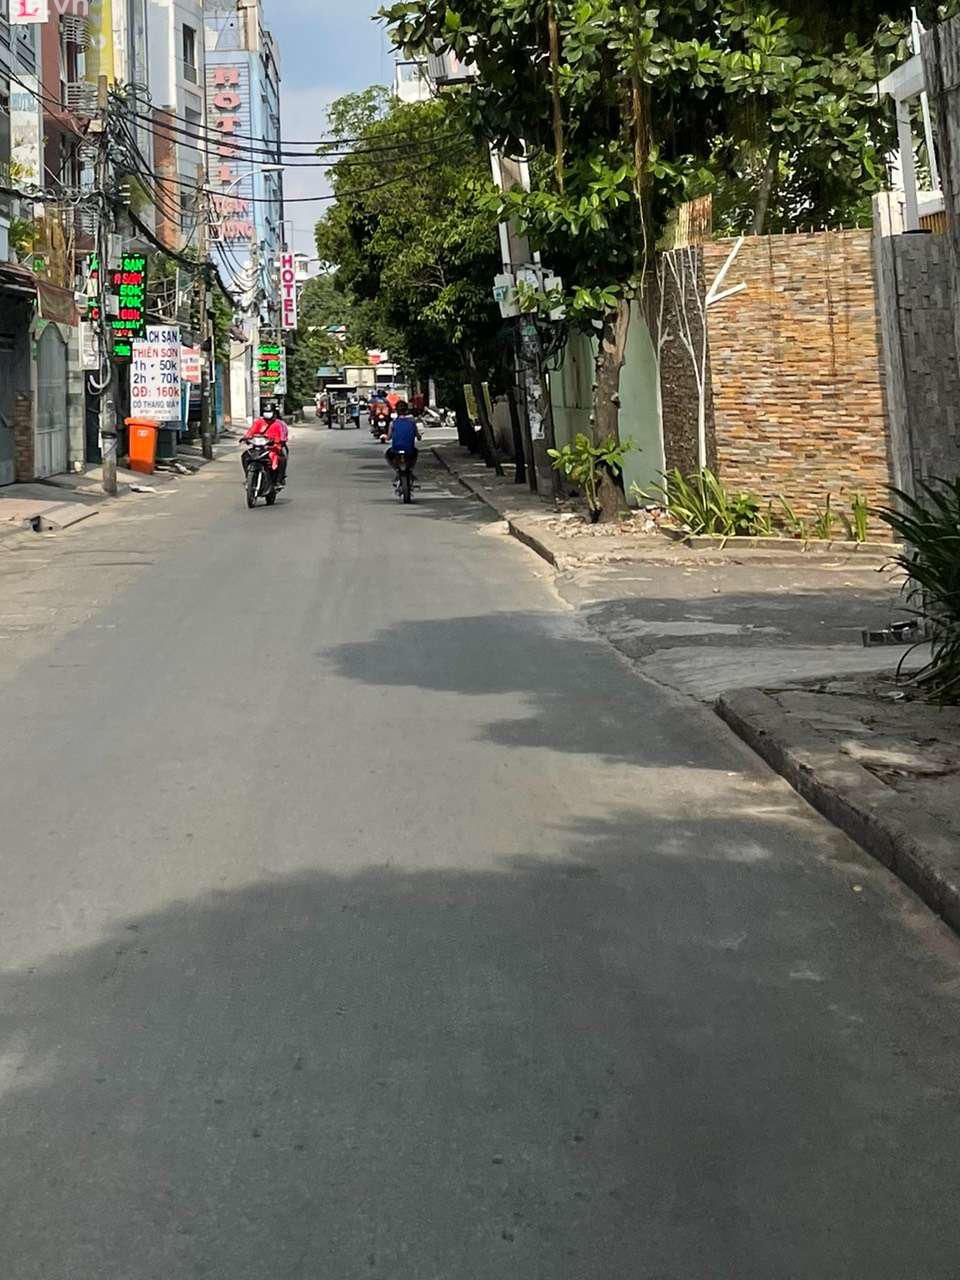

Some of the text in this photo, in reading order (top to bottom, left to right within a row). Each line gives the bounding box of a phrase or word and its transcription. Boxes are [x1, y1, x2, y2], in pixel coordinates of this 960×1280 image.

[281, 255, 295, 327] HOTEL
[159, 359, 177, 371] 50k
[133, 373, 147, 384] 2h
[160, 373, 179, 384] 70k
[156, 386, 180, 398] 160k
